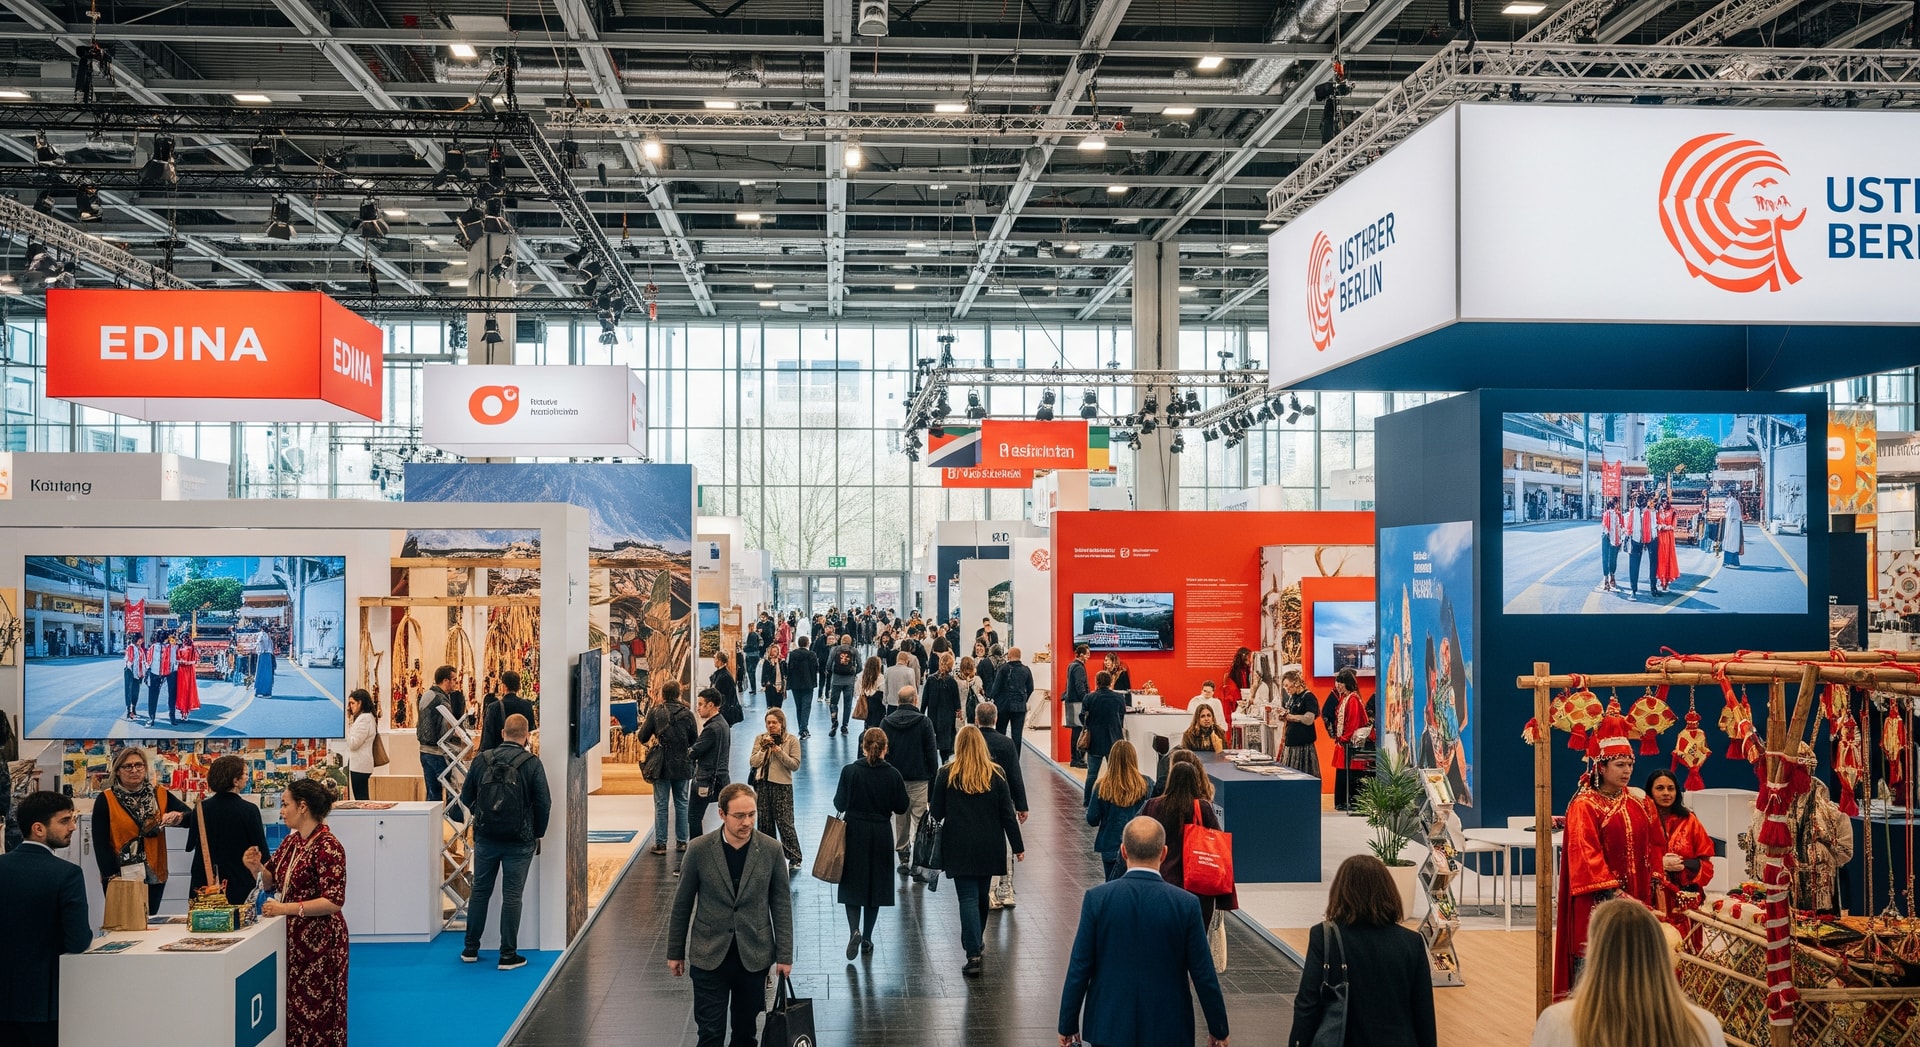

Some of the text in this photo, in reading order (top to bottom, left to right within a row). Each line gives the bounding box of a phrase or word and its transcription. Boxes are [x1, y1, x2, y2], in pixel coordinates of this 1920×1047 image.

[1826, 176, 1920, 214] UST
[1828, 223, 1920, 260] BER
[1340, 260, 1383, 313] BERLIN
[100, 325, 268, 362] EDINA
[333, 337, 373, 387] EDINA
